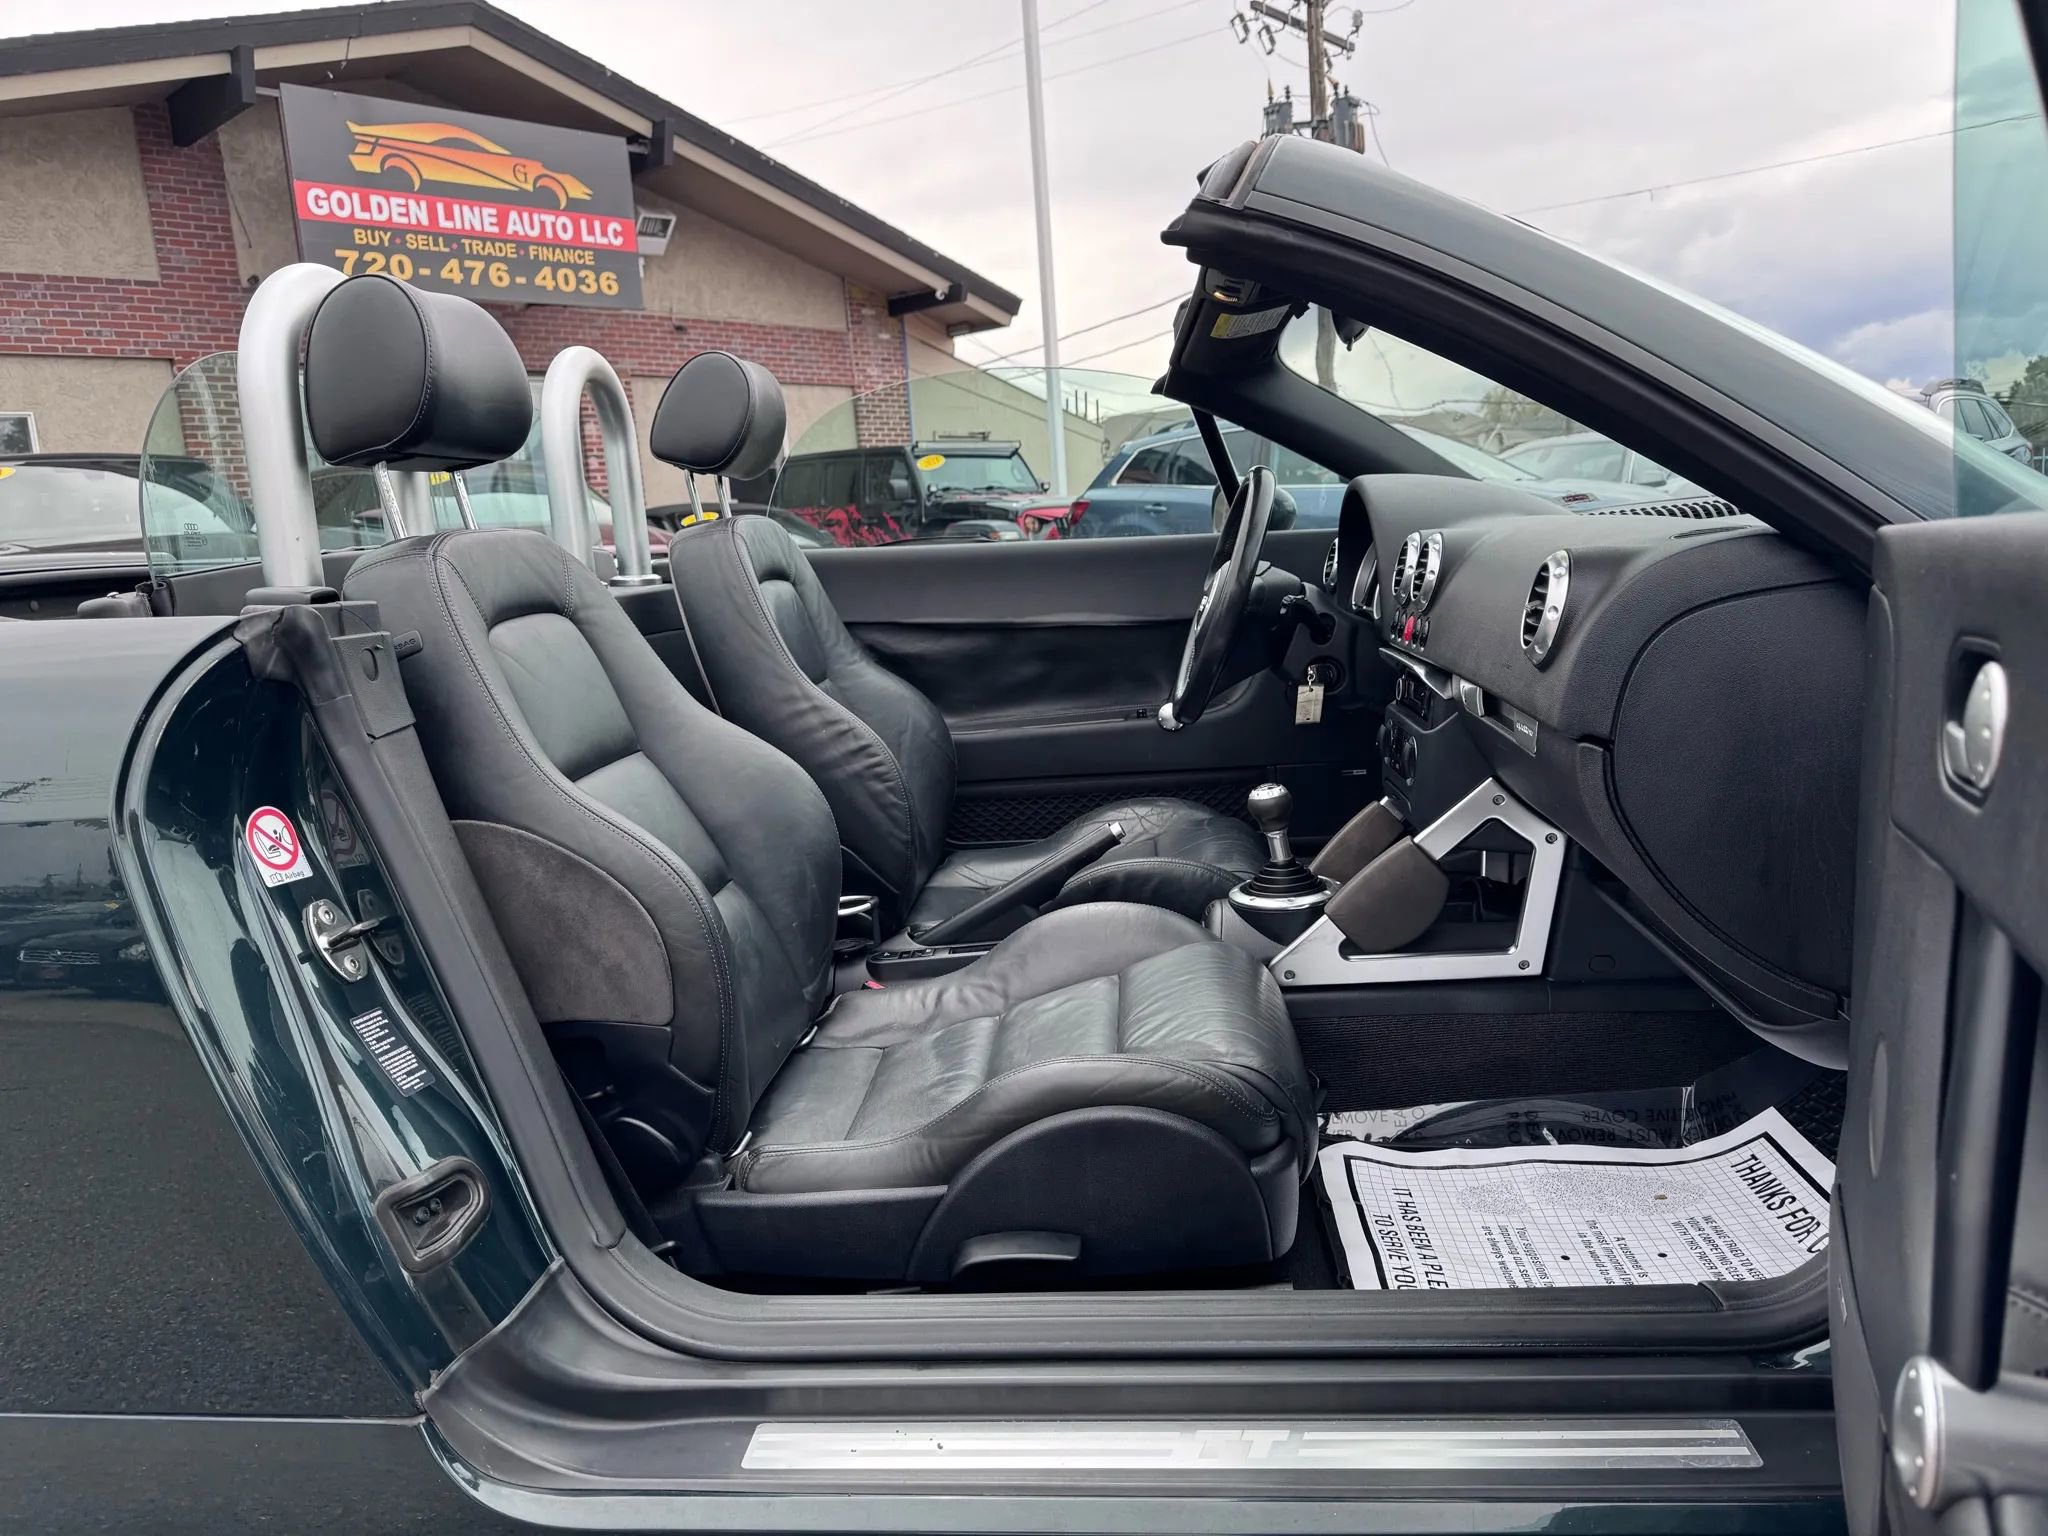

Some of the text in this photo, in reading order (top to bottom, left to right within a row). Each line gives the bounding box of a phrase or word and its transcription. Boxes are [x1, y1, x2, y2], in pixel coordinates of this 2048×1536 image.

[306, 187, 624, 246] GOLDEN LINE AUTO LLC
[353, 228, 595, 265] BUY SELL TRADE FINANCE
[1582, 1109, 1638, 1123] COVER
[1391, 1187, 1413, 1198] IT
[1730, 1153, 1797, 1211] THANKS
[1776, 1207, 1821, 1244] FOR
[1373, 1214, 1395, 1226] TO
[1396, 1200, 1422, 1222] HAS
[1406, 1224, 1434, 1251] BEEN
[1481, 1225, 1494, 1236] are
[1516, 1227, 1529, 1242] Your
[1671, 1220, 1690, 1236] WITH
[1683, 1236, 1702, 1251] THIS
[1694, 1250, 1718, 1270] PAPER
[1701, 1215, 1717, 1225] WE
[1709, 1225, 1730, 1240] HAVE
[1722, 1239, 1745, 1258] TRIED
[1738, 1258, 1753, 1268] TO
[1378, 1229, 1410, 1262] SERVE
[1417, 1252, 1438, 1260] A
[1487, 1237, 1504, 1259] always
[1498, 1225, 1520, 1255] improving
[1513, 1256, 1526, 1268] our
[1581, 1239, 1594, 1249] the
[1588, 1249, 1608, 1268] world
[1592, 1231, 1610, 1245] most
[1601, 1247, 1631, 1277] important
[1617, 1243, 1643, 1270] customer
[1685, 1216, 1746, 1281] YOUR CARPETING CLEA
[1522, 1242, 1550, 1280] suggestions
